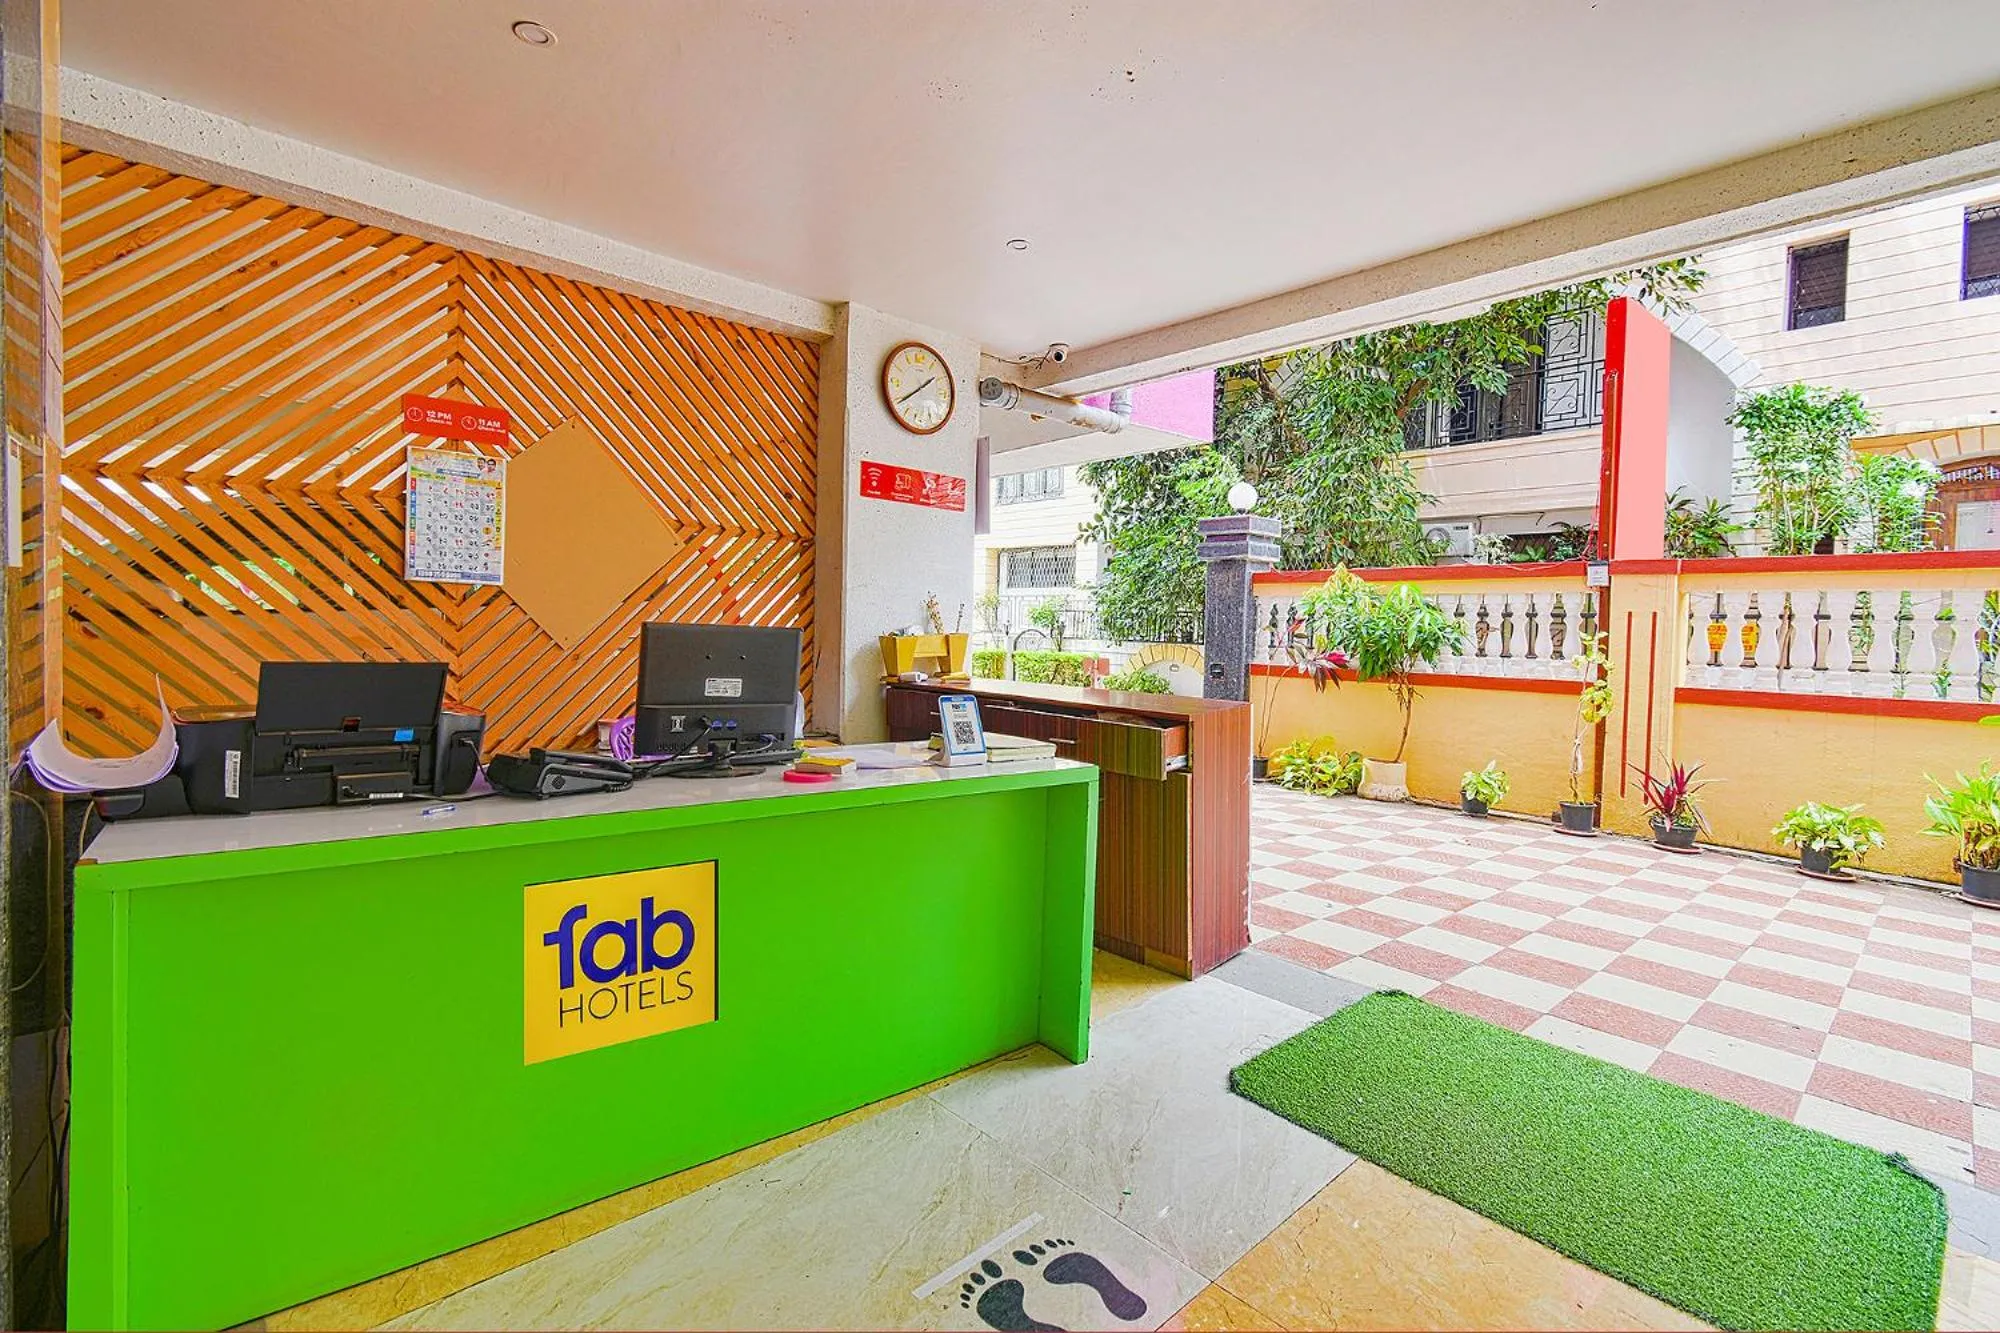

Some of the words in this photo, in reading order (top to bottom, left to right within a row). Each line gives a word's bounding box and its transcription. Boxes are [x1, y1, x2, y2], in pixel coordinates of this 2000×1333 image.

[426, 410, 436, 418] 12
[437, 412, 452, 420] PM
[478, 418, 486, 426] 11
[486, 420, 501, 428] AM
[544, 896, 695, 990] fab
[559, 971, 694, 1028] HOTELS
